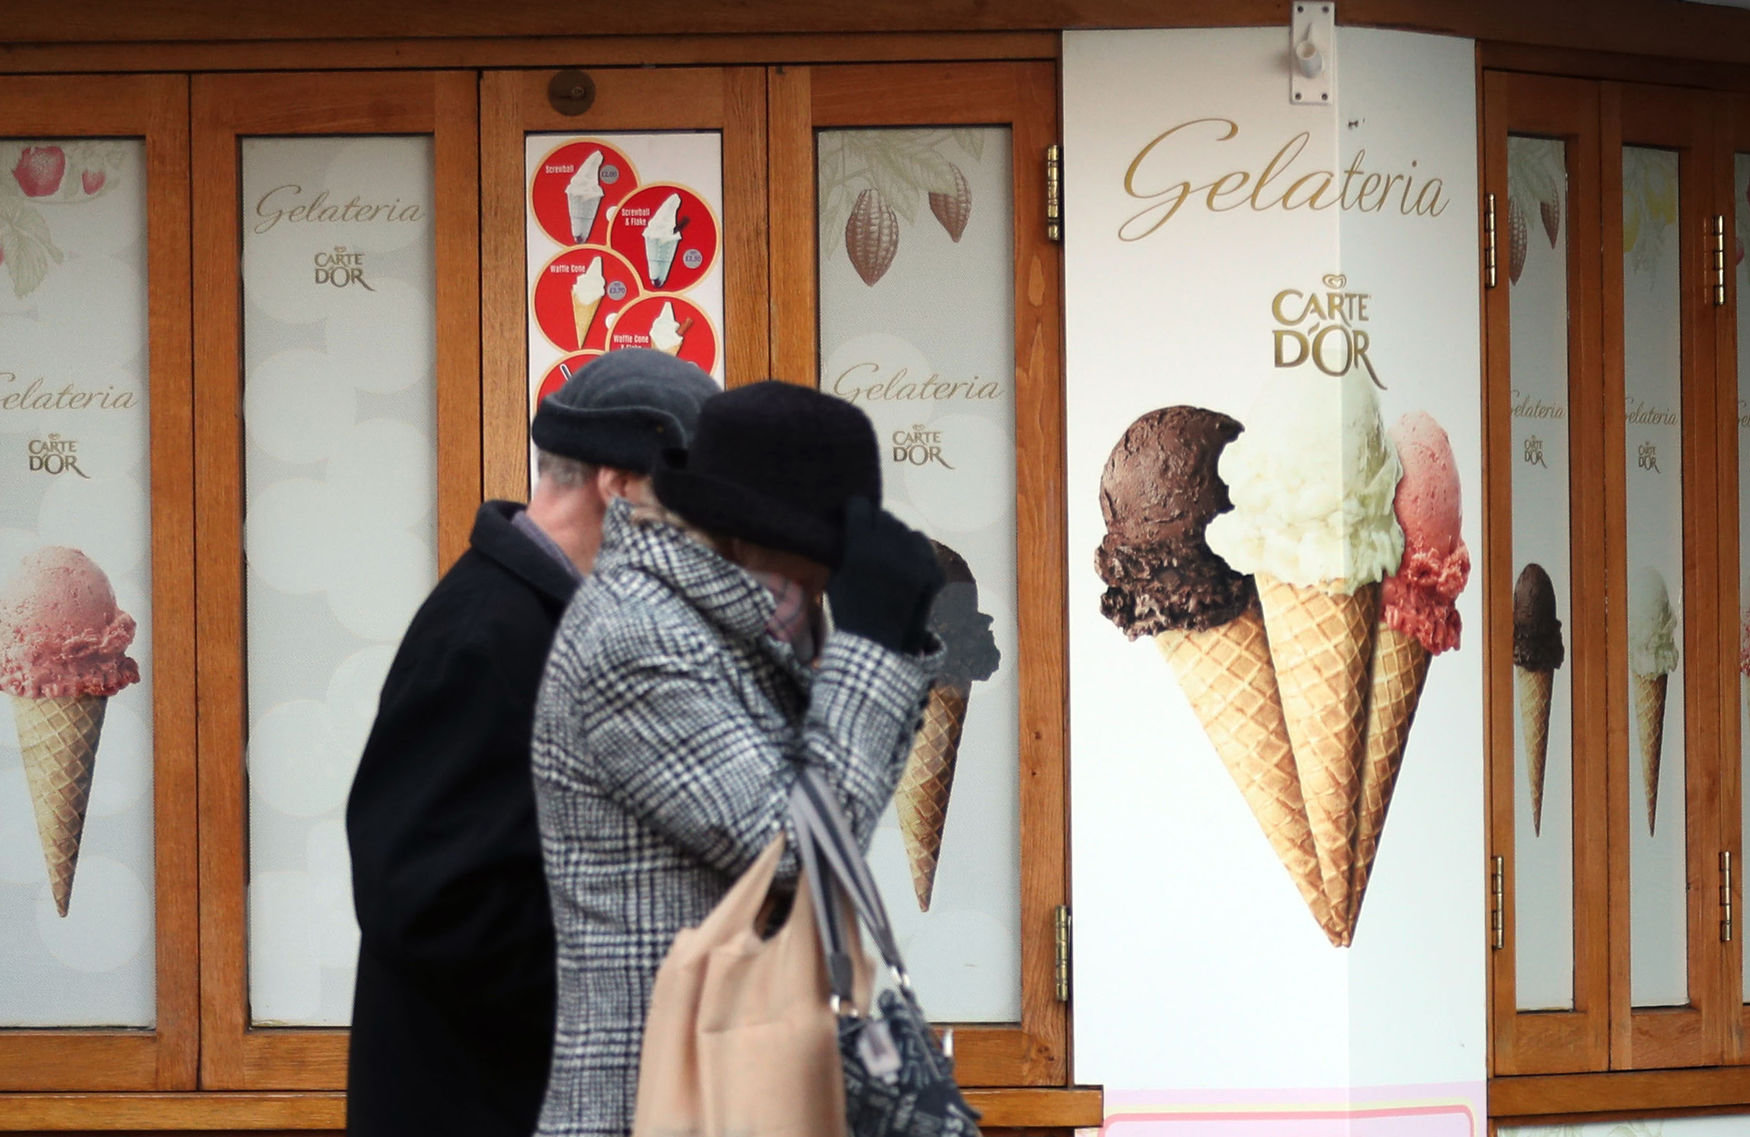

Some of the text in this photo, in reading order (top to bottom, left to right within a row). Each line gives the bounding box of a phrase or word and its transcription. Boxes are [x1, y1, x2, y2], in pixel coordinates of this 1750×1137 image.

[1117, 117, 1449, 242] Gelateria
[253, 184, 425, 235] Gelateria
[314, 251, 364, 269] CARTE
[550, 265, 569, 273] Waffle
[1271, 288, 1370, 328] CARTE
[1273, 321, 1388, 391] D'OR
[833, 362, 1004, 404] Gelateria
[1510, 388, 1567, 418] elateria
[1625, 396, 1679, 425] elateria
[28, 439, 78, 455] CARTE
[892, 430, 942, 446] CARTE
